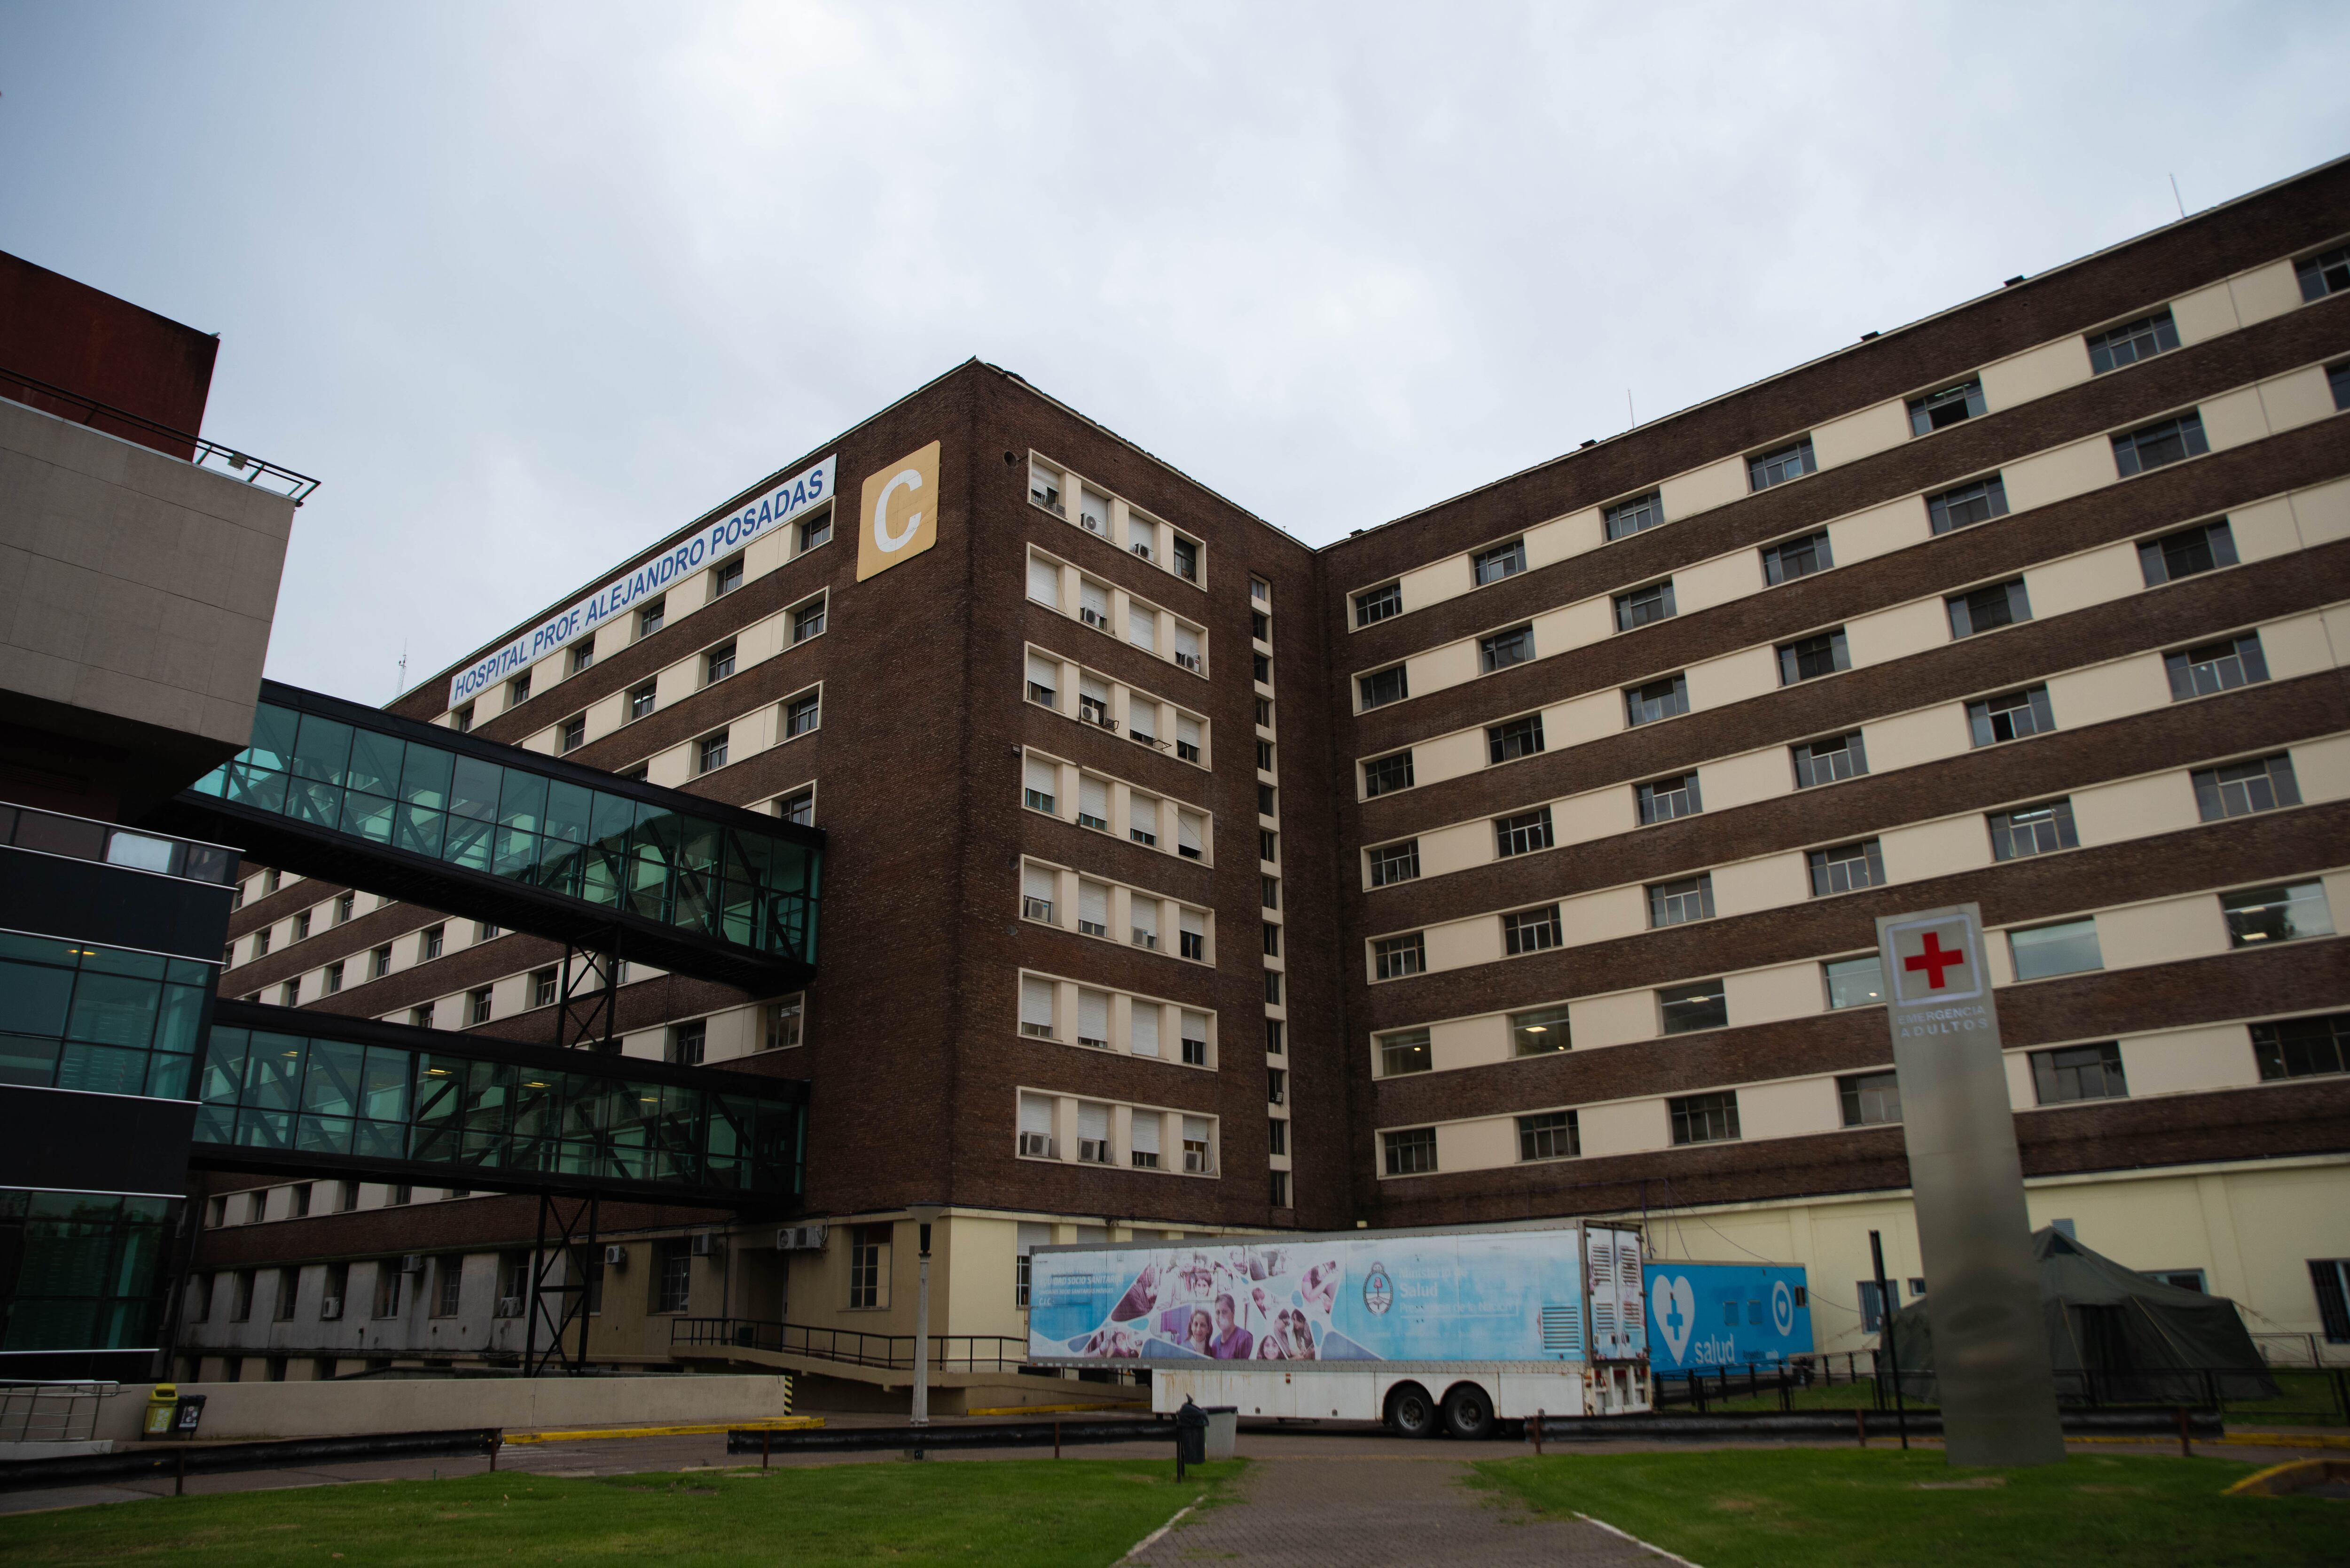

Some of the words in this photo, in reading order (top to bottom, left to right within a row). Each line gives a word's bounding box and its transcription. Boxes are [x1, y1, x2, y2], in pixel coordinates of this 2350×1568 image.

[874, 469, 922, 552] C
[454, 641, 527, 700] HOSPITAL
[533, 609, 580, 656] PROF.
[585, 538, 705, 626] ALEJANDRO
[711, 470, 823, 555] POSADAS
[1897, 1005, 1985, 1024] EMERGENCIA
[1901, 1018, 1988, 1038] ADULTOS
[1399, 1268, 1450, 1279] Ministerio
[1400, 1281, 1438, 1298] Salud
[1694, 1333, 1735, 1364] salud
